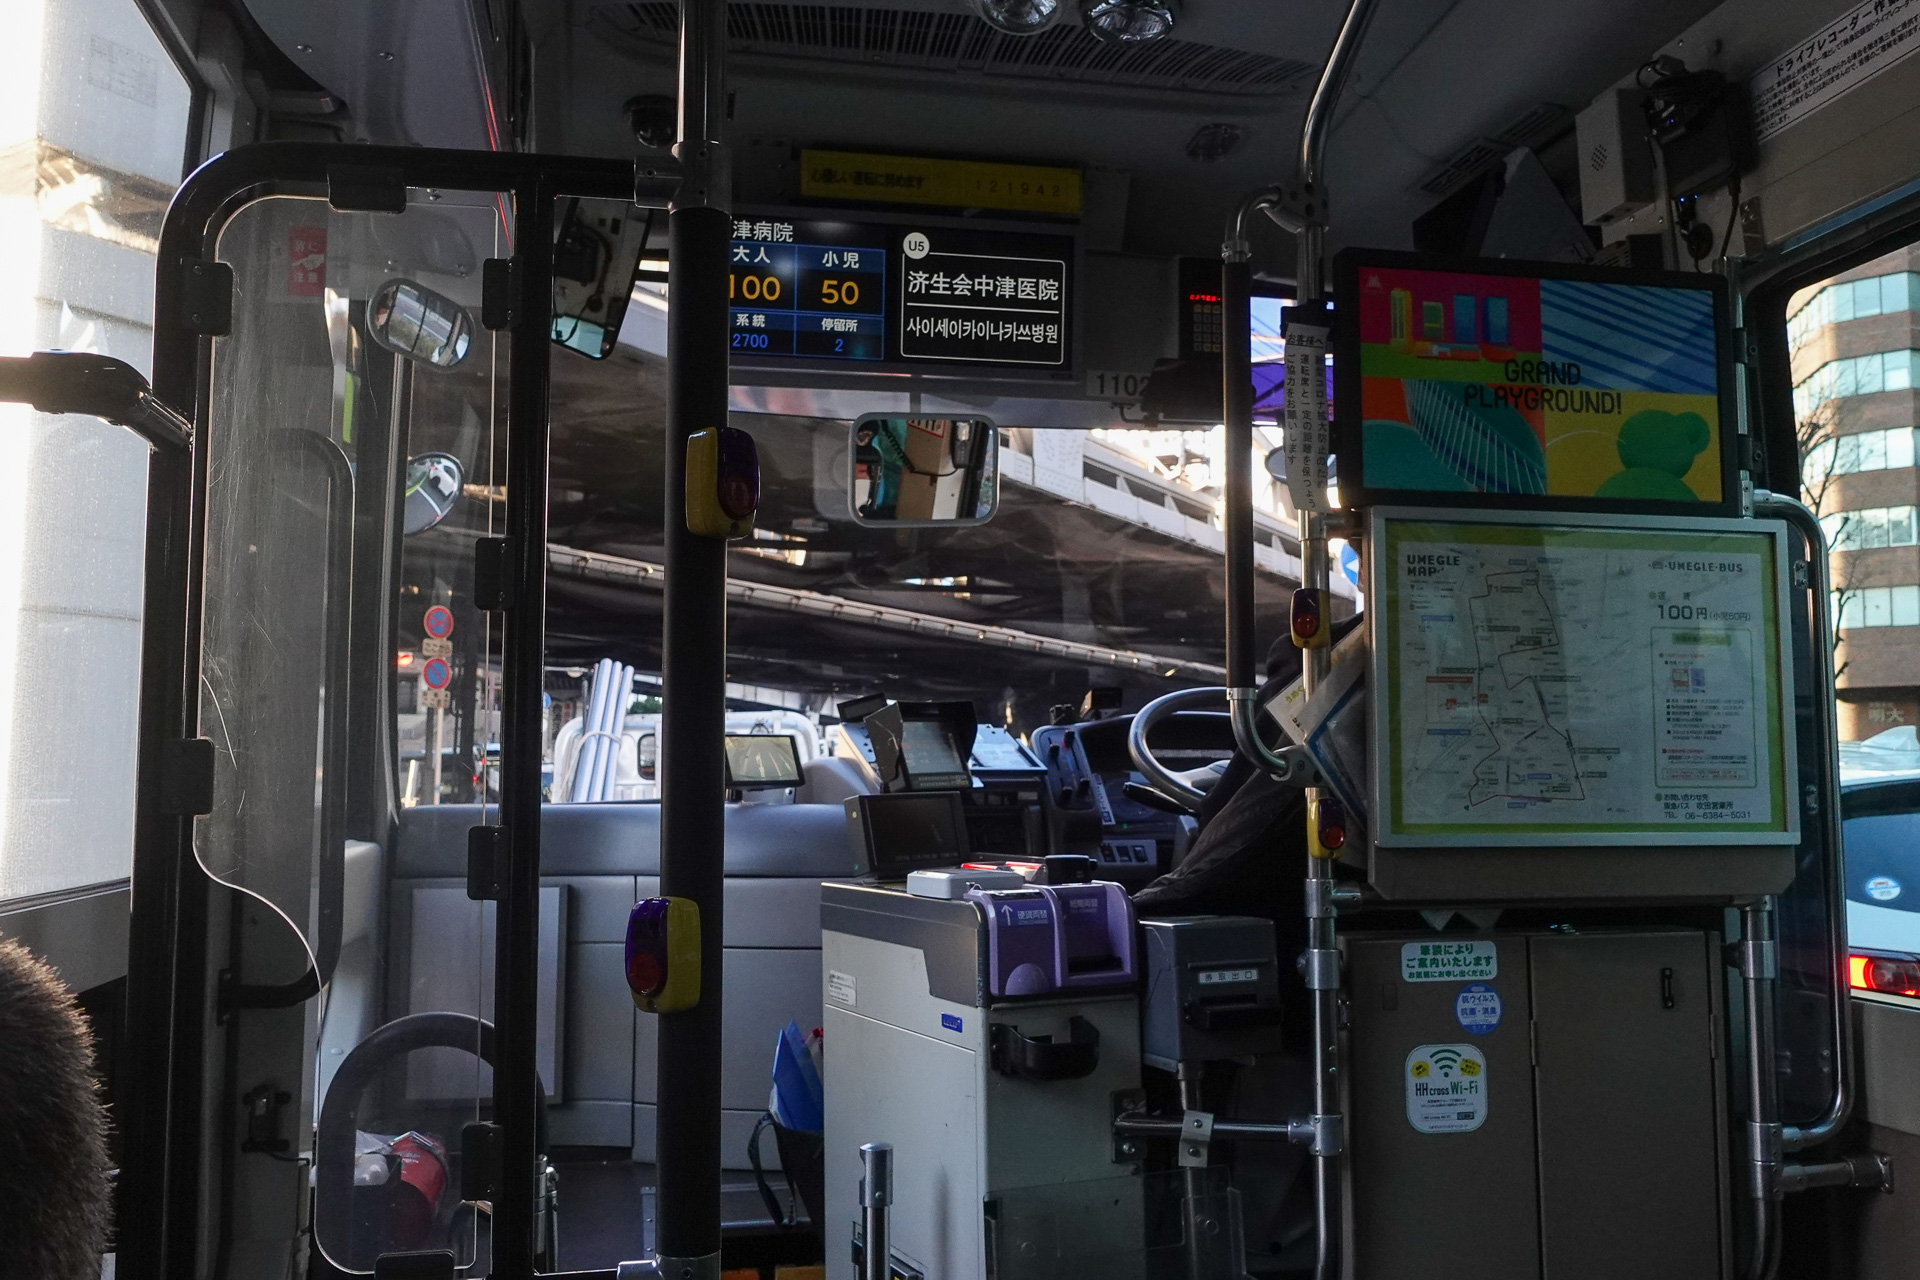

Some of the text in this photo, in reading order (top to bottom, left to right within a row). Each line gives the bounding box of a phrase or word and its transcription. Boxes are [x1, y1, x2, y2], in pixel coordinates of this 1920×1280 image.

[732, 220, 794, 242] 津病院
[908, 240, 925, 252] U5
[733, 245, 859, 269] 大人 小児
[729, 274, 859, 305] 100 50
[907, 270, 1059, 301] 済生会中津医院
[736, 313, 858, 332] 系統 停留所
[906, 316, 1058, 344] 사이세이카이나카쓰병원
[732, 333, 844, 352] 2700 2
[1288, 334, 1323, 345] お客様へ
[1504, 359, 1581, 386] GRAND
[1286, 353, 1298, 465] ご協力をお願いします
[1464, 384, 1622, 415] PLAYGROUND!
[1407, 554, 1460, 566] UMEGLE
[1407, 566, 1437, 576] MAP
[1663, 793, 1709, 802] お問い合わせ先
[1406, 955, 1493, 969] ご案内いたします
[1415, 1080, 1478, 1097] HH cross Wi-Fi
